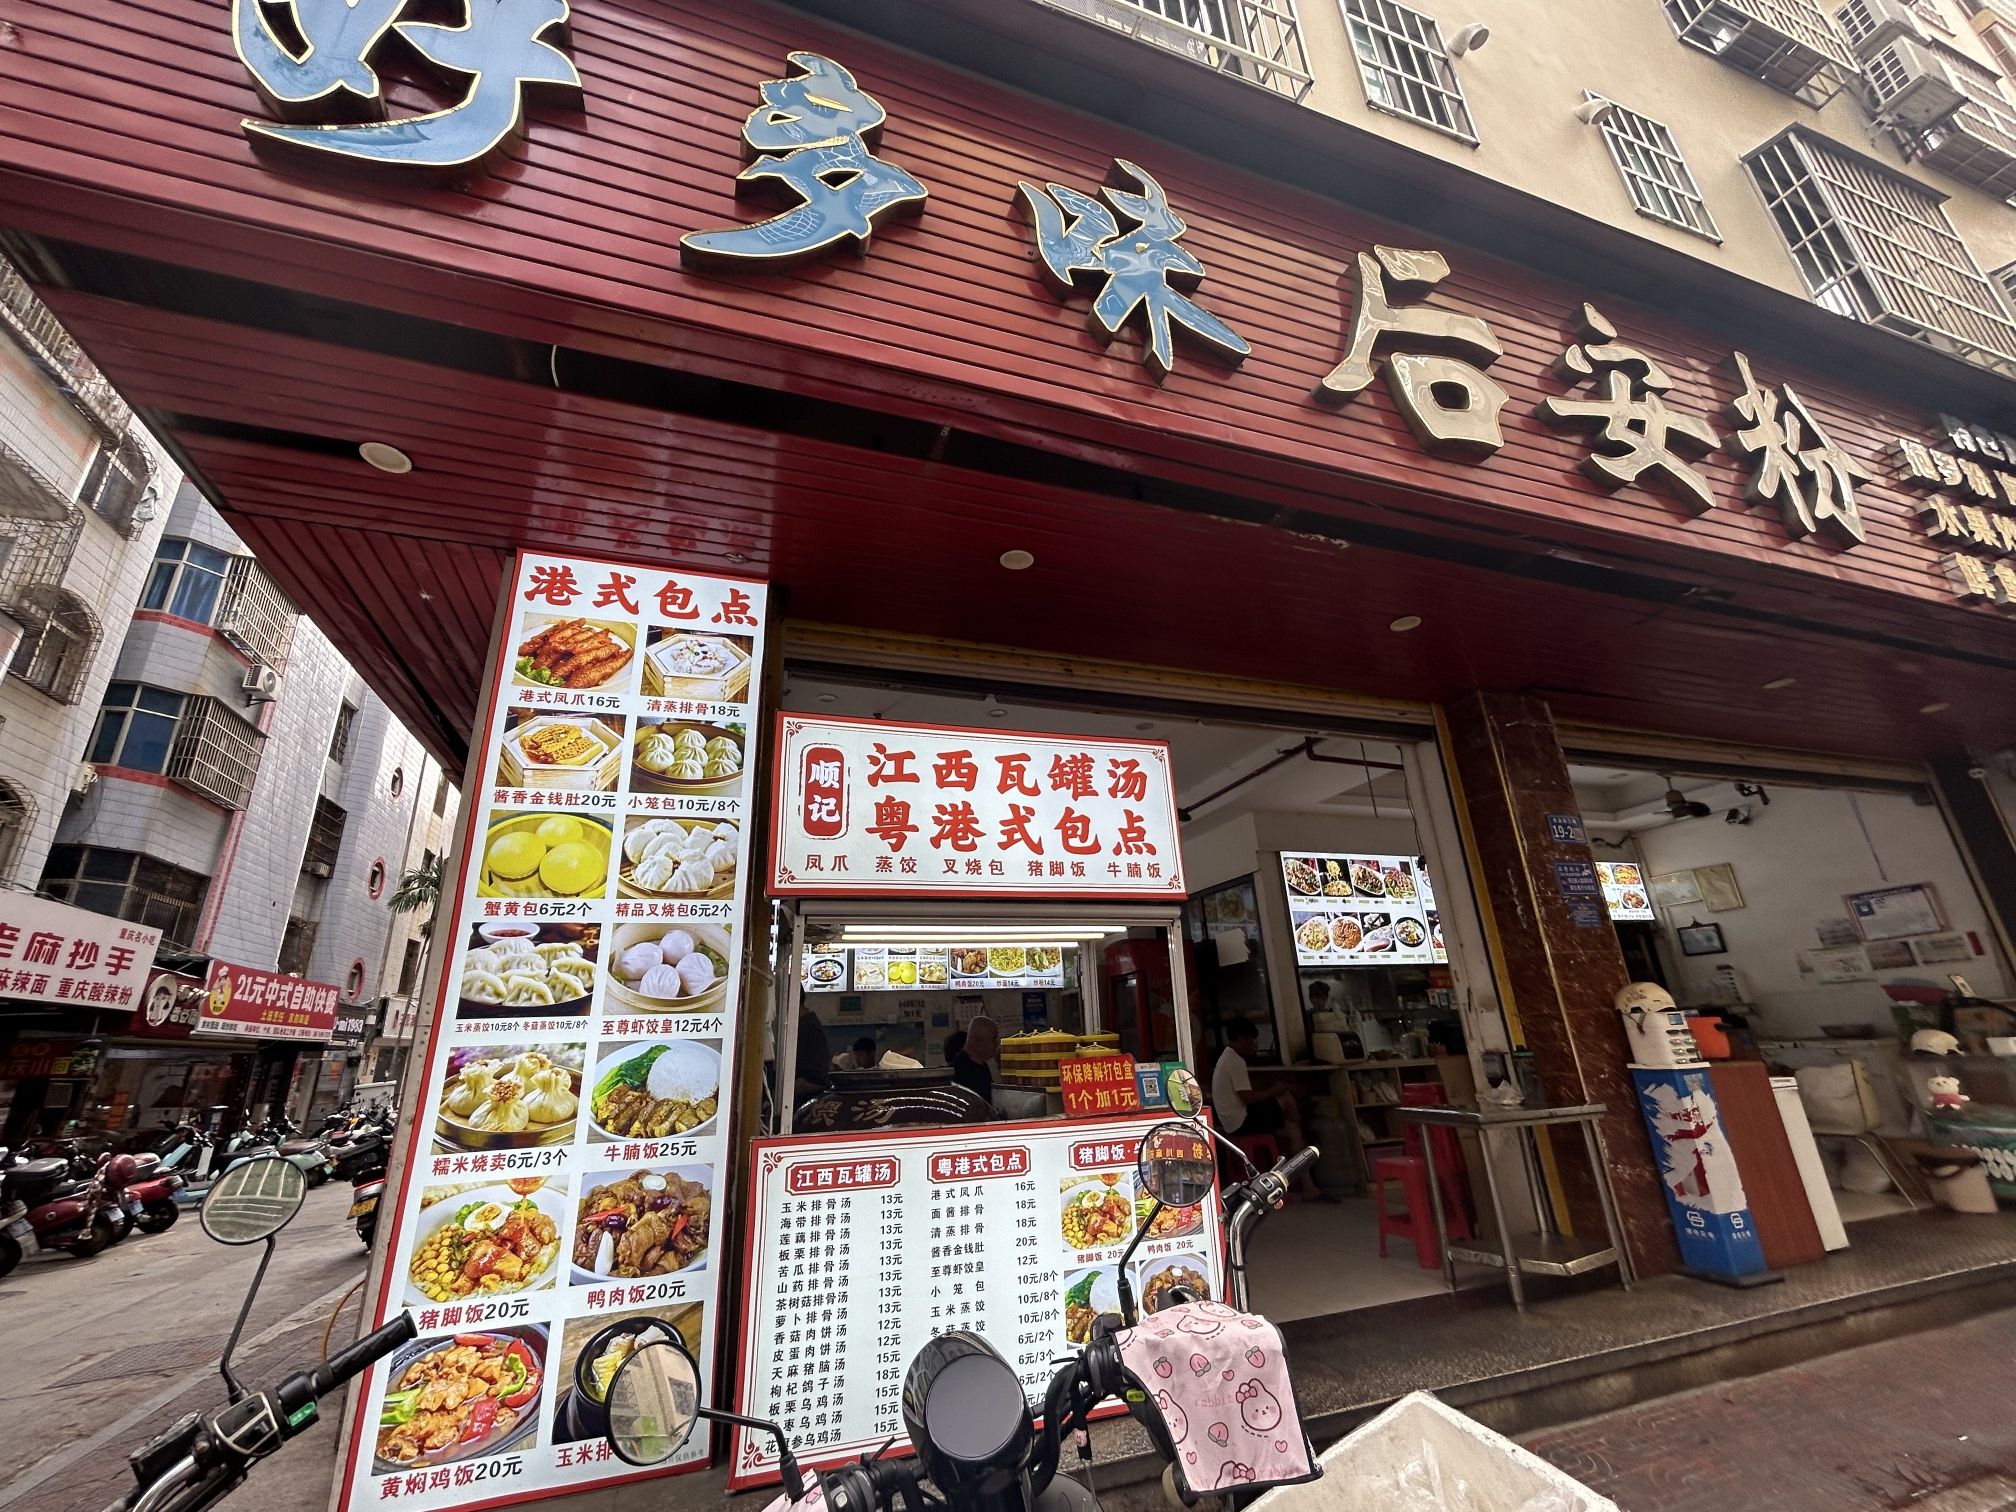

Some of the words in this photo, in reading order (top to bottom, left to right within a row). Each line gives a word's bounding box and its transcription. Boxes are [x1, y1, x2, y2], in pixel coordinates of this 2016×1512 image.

[524, 565, 759, 627] 港式包点
[519, 689, 621, 709] 港式凤爪16元
[646, 698, 741, 717] 清蒸排骨18元
[866, 742, 1148, 802] 江西瓦罐汤
[493, 789, 617, 808] 酱香金钱肚20元
[809, 759, 842, 823] 顺记
[628, 795, 741, 813] 小笼包10元/8个
[865, 795, 1157, 857] 粤港式包点
[804, 854, 849, 873] 凤爪
[875, 856, 918, 874] 蒸饺
[942, 858, 1005, 877] 叉烧包
[1027, 860, 1087, 878] 猪脚饭
[1106, 861, 1162, 879] 牛腩饭
[484, 901, 592, 917] 蟹黄包6元2个
[615, 903, 732, 917] 精品叉烧包6元2个
[55, 978, 133, 1005] 重庆酸辣粉
[233, 974, 339, 1015] 21元中式自助快餐
[455, 1022, 520, 1033] 玉米蒸饺10元8个
[601, 1017, 723, 1035] 至尊虾饺皇12元4个
[1062, 1060, 1134, 1084] 环保降解打包盒
[432, 1149, 568, 1176] 糯米烧卖6元/3个
[604, 1141, 697, 1162] 牛腩饭25元
[796, 1163, 891, 1187] 江西瓦罐汤
[937, 1152, 1022, 1176] 粤港式包点
[931, 1185, 984, 1200] 港式凤爪
[1015, 1181, 1036, 1191] 16元
[781, 1197, 851, 1213] 玉米排骨汤
[881, 1194, 903, 1204] 13元
[931, 1204, 984, 1219] 面酱排骨
[1015, 1199, 1036, 1209] 18元
[780, 1213, 851, 1230] 海带排骨汤
[881, 1209, 903, 1219] 13元
[931, 1223, 984, 1238] 清蒸排骨
[1016, 1217, 1037, 1228] 18元
[779, 1228, 850, 1245] 莲藕排骨汤
[880, 1224, 903, 1235] 13元
[779, 1243, 850, 1261] 板栗排骨汤
[880, 1239, 902, 1250] 13元
[931, 1242, 985, 1258] 酱香金钱肚
[1016, 1236, 1038, 1247] 20元
[1077, 1252, 1102, 1264] 猪脚饭
[1147, 1242, 1171, 1254] 鸭肉饭
[1177, 1240, 1193, 1249] 20元
[778, 1259, 850, 1278] 苦瓜排骨汤
[879, 1254, 902, 1266] 13元
[931, 1261, 985, 1278] 至尊虾饺皇
[1017, 1254, 1038, 1265] 12元
[587, 1280, 686, 1308] 鸭肉饭20元
[777, 1275, 849, 1294] 山药排骨汤
[879, 1270, 902, 1281] 13元
[931, 1280, 985, 1298] 小笼包
[1018, 1270, 1058, 1285] 10元/8个
[776, 1291, 848, 1311] 茶树菇排骨汤
[879, 1286, 902, 1297] 13元
[931, 1300, 986, 1318] 玉米蒸饺
[1018, 1289, 1059, 1304] 10元/8个
[419, 1299, 530, 1330] 猪脚饭20元
[775, 1307, 848, 1328] 萝卜排骨汤
[878, 1302, 902, 1314] 13元
[1018, 1308, 1060, 1324] 10元/8个
[774, 1324, 847, 1345] 香菇肉饼汤
[878, 1318, 901, 1330] 12元
[1018, 1329, 1054, 1345] 6元/2个
[773, 1341, 846, 1363] 皮蛋肉饼汤
[877, 1334, 901, 1346] 12元
[1018, 1349, 1055, 1365] 6元/3个
[772, 1358, 846, 1380] 天麻猪脑汤
[877, 1351, 900, 1363] 15元
[770, 1375, 844, 1398] 枸杞鸽子汤
[876, 1367, 900, 1380] 18元
[769, 1393, 843, 1416] 板栗乌鸡汤
[876, 1384, 899, 1398] 15元
[767, 1410, 842, 1435] 枣乌鸡汤
[875, 1402, 899, 1415] 15元
[874, 1419, 898, 1433] 15元
[380, 1456, 523, 1500] 黄焖鸡饭20元
